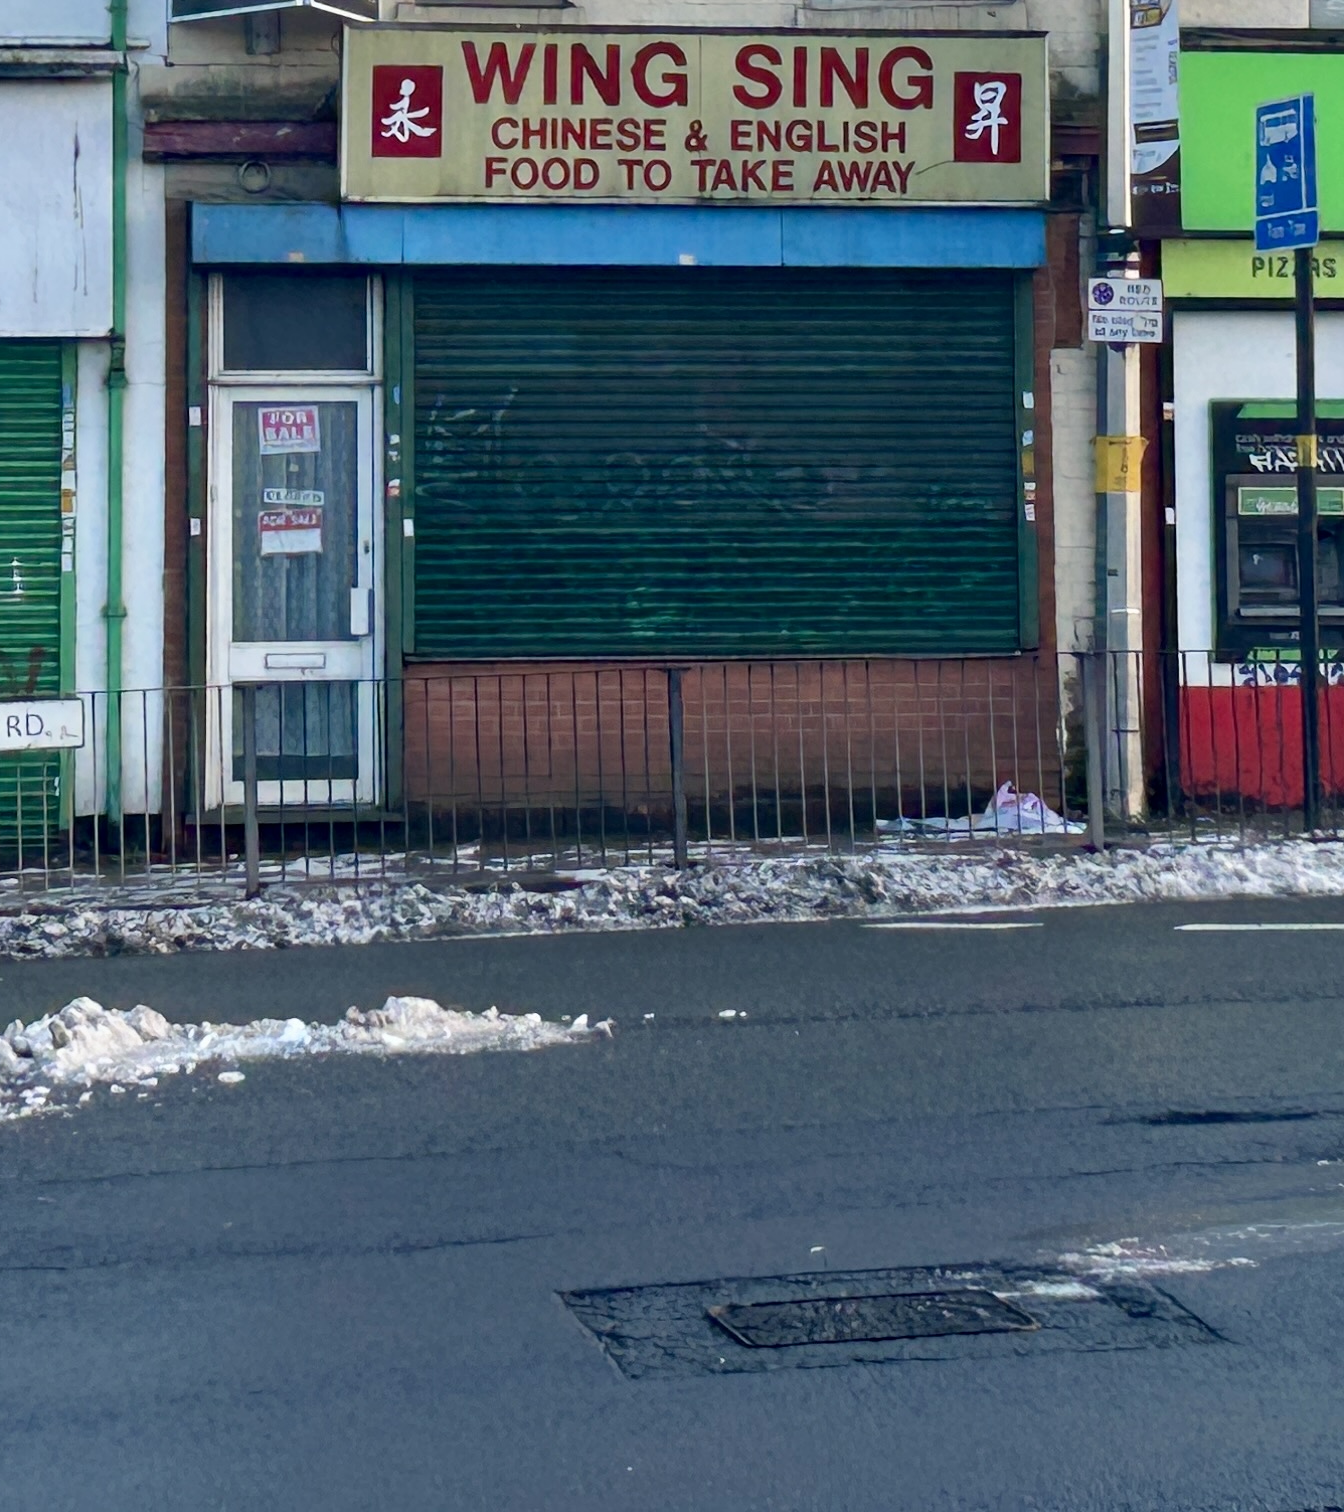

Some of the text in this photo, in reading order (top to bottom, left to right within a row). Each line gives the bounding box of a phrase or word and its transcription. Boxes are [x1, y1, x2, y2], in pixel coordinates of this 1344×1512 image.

[460, 40, 934, 110] WING SING
[380, 79, 438, 142] 永
[490, 118, 907, 154] CHINESE & ENGLISH
[484, 157, 916, 194] FOOD TO TAKE AWAY
[1251, 256, 1337, 278] PIZAS
